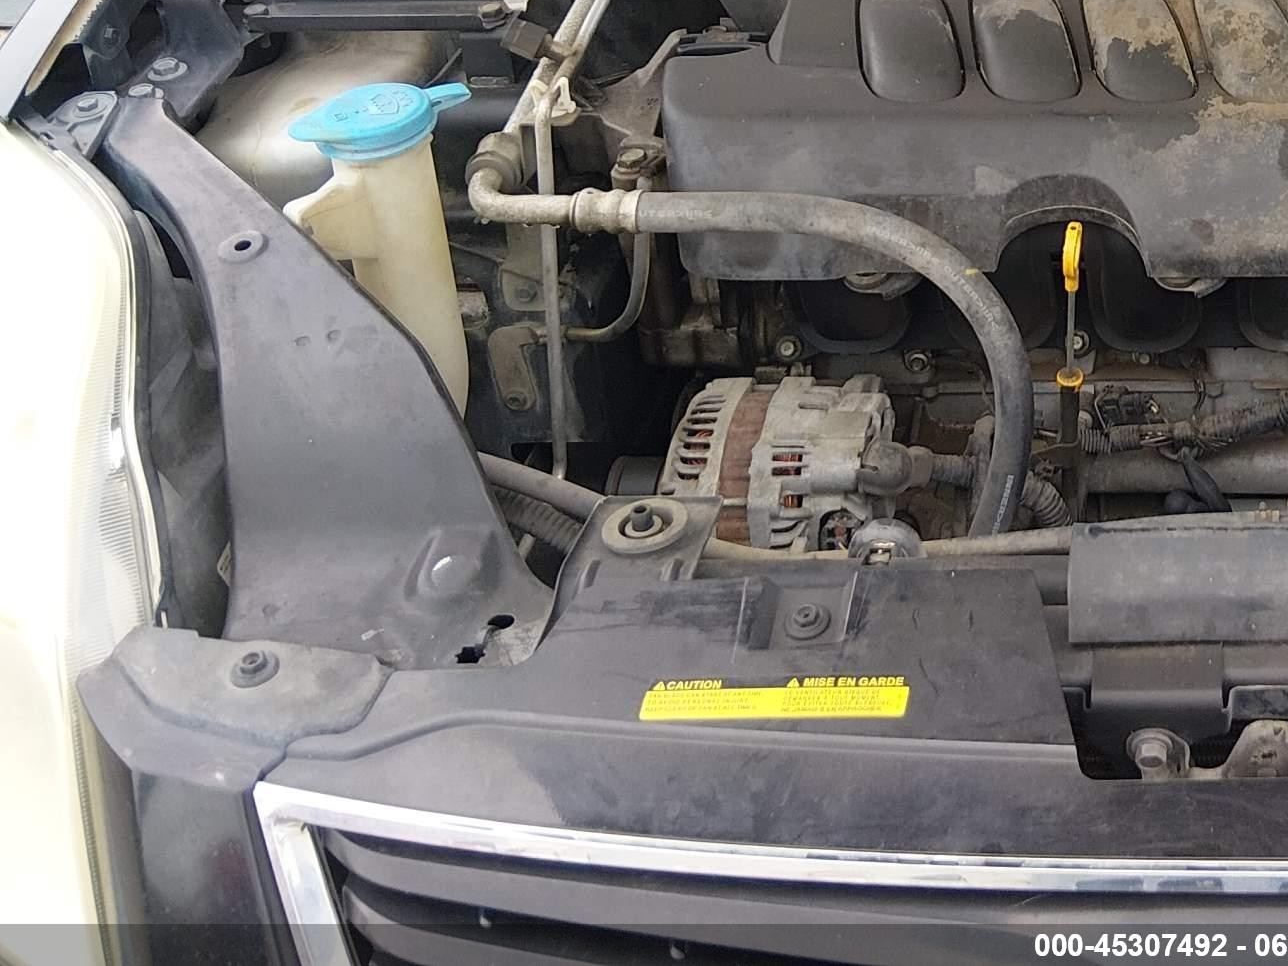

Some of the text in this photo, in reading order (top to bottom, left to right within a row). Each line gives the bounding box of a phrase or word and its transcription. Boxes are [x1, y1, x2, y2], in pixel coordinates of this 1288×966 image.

[666, 679, 722, 690] CAUTION
[803, 677, 904, 687] MISE EN GARDE
